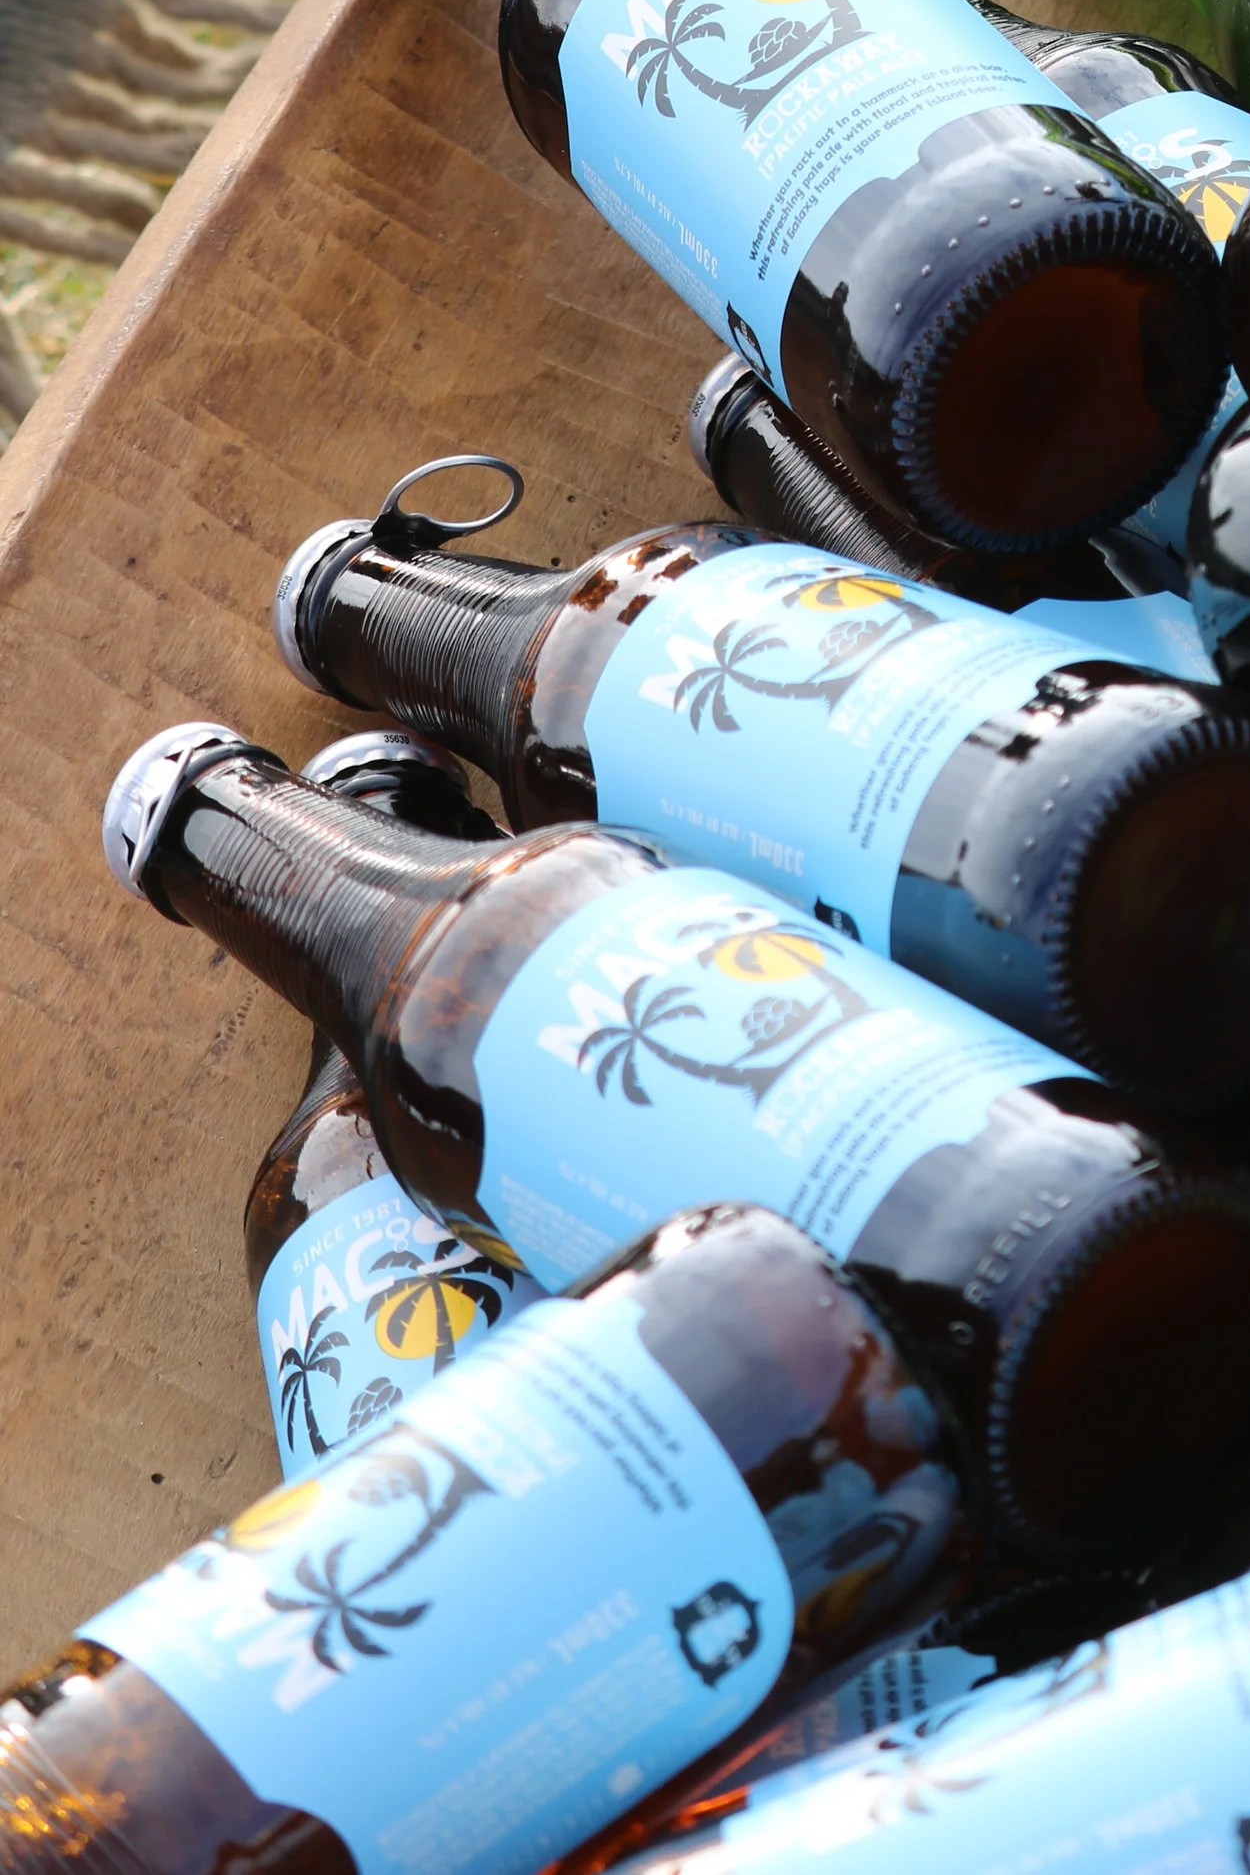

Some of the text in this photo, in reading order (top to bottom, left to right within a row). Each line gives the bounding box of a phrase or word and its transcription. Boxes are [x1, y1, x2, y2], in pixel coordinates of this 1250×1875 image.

[742, 32, 901, 162] ROCKAWAY
[749, 202, 777, 262] Whether
[775, 177, 793, 205] you
[790, 150, 816, 179] rock
[815, 127, 836, 150] out
[834, 113, 852, 129] in
[851, 107, 862, 118] a
[859, 76, 918, 110] hammock
[920, 67, 938, 83] or
[756, 254, 771, 283] this
[766, 188, 806, 256] refreshing
[801, 158, 826, 192] pale
[822, 140, 844, 163] ale
[841, 117, 873, 143] with
[871, 93, 911, 121] floral
[910, 82, 936, 101] and
[937, 73, 991, 92] tropical
[780, 237, 791, 257] of
[816, 163, 843, 198] hops
[841, 150, 855, 167] is
[853, 127, 884, 157] your
[884, 103, 925, 132] desert
[292, 1197, 403, 1278] SINCE 1981
[962, 1189, 1073, 1308] REFILL
